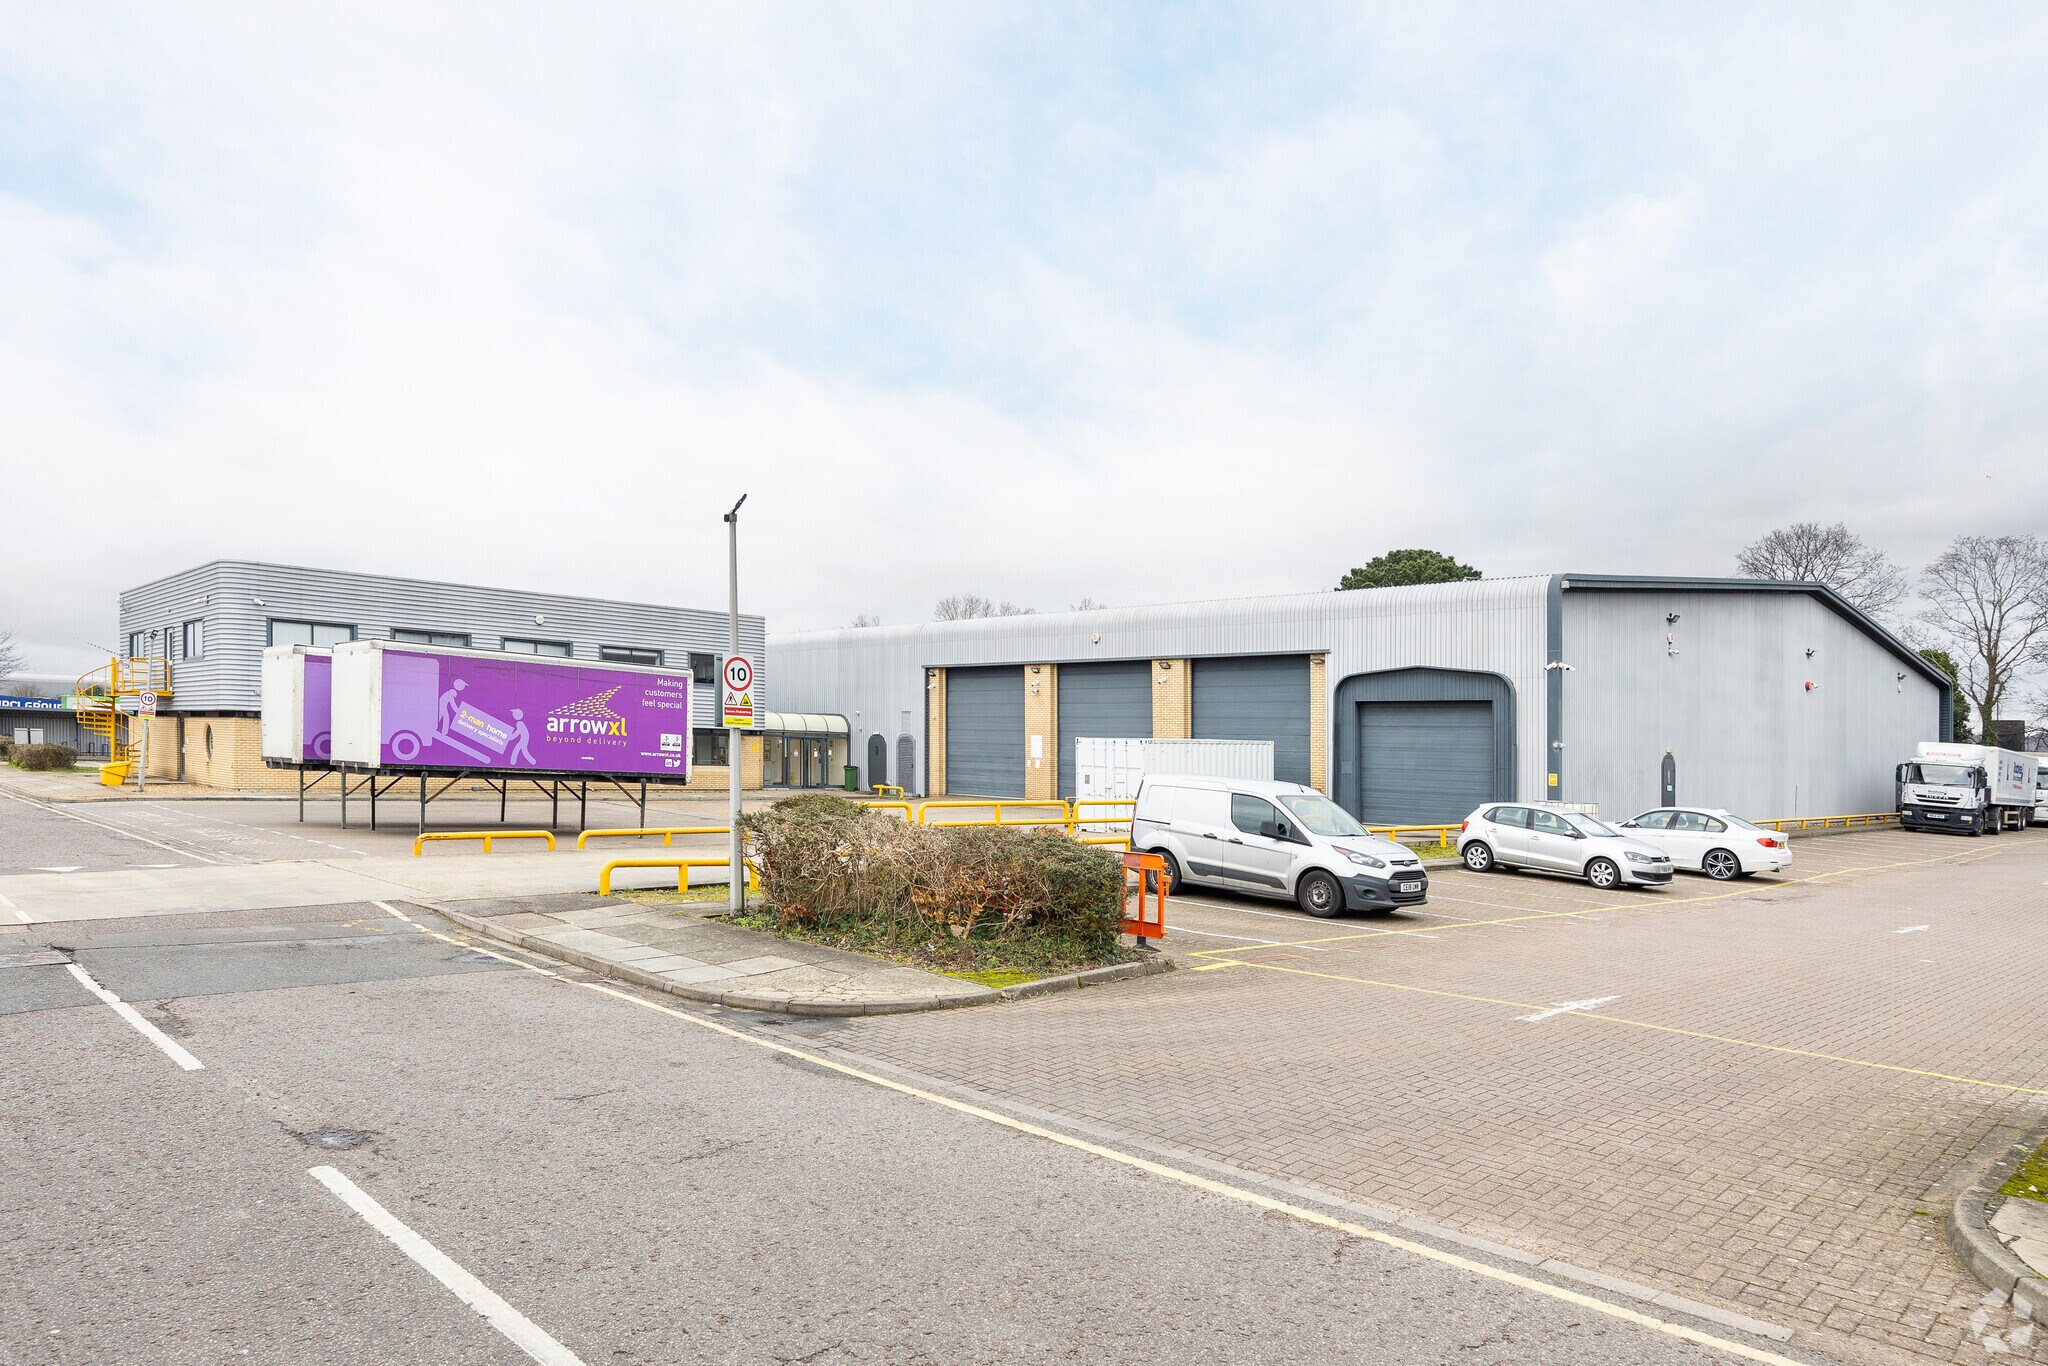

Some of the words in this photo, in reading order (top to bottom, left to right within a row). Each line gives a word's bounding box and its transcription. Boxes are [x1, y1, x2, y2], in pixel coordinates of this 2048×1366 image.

[730, 667, 747, 681] 10
[657, 677, 683, 690] Making
[644, 689, 683, 699] customers
[642, 698, 656, 707] feel
[657, 700, 683, 709] special
[460, 710, 485, 728] 2-man
[486, 723, 508, 739] home
[546, 716, 627, 736] arrowxl
[457, 719, 478, 732] delivery
[478, 729, 504, 746] specialists
[546, 734, 582, 744] beyond
[587, 737, 627, 747] delivery
